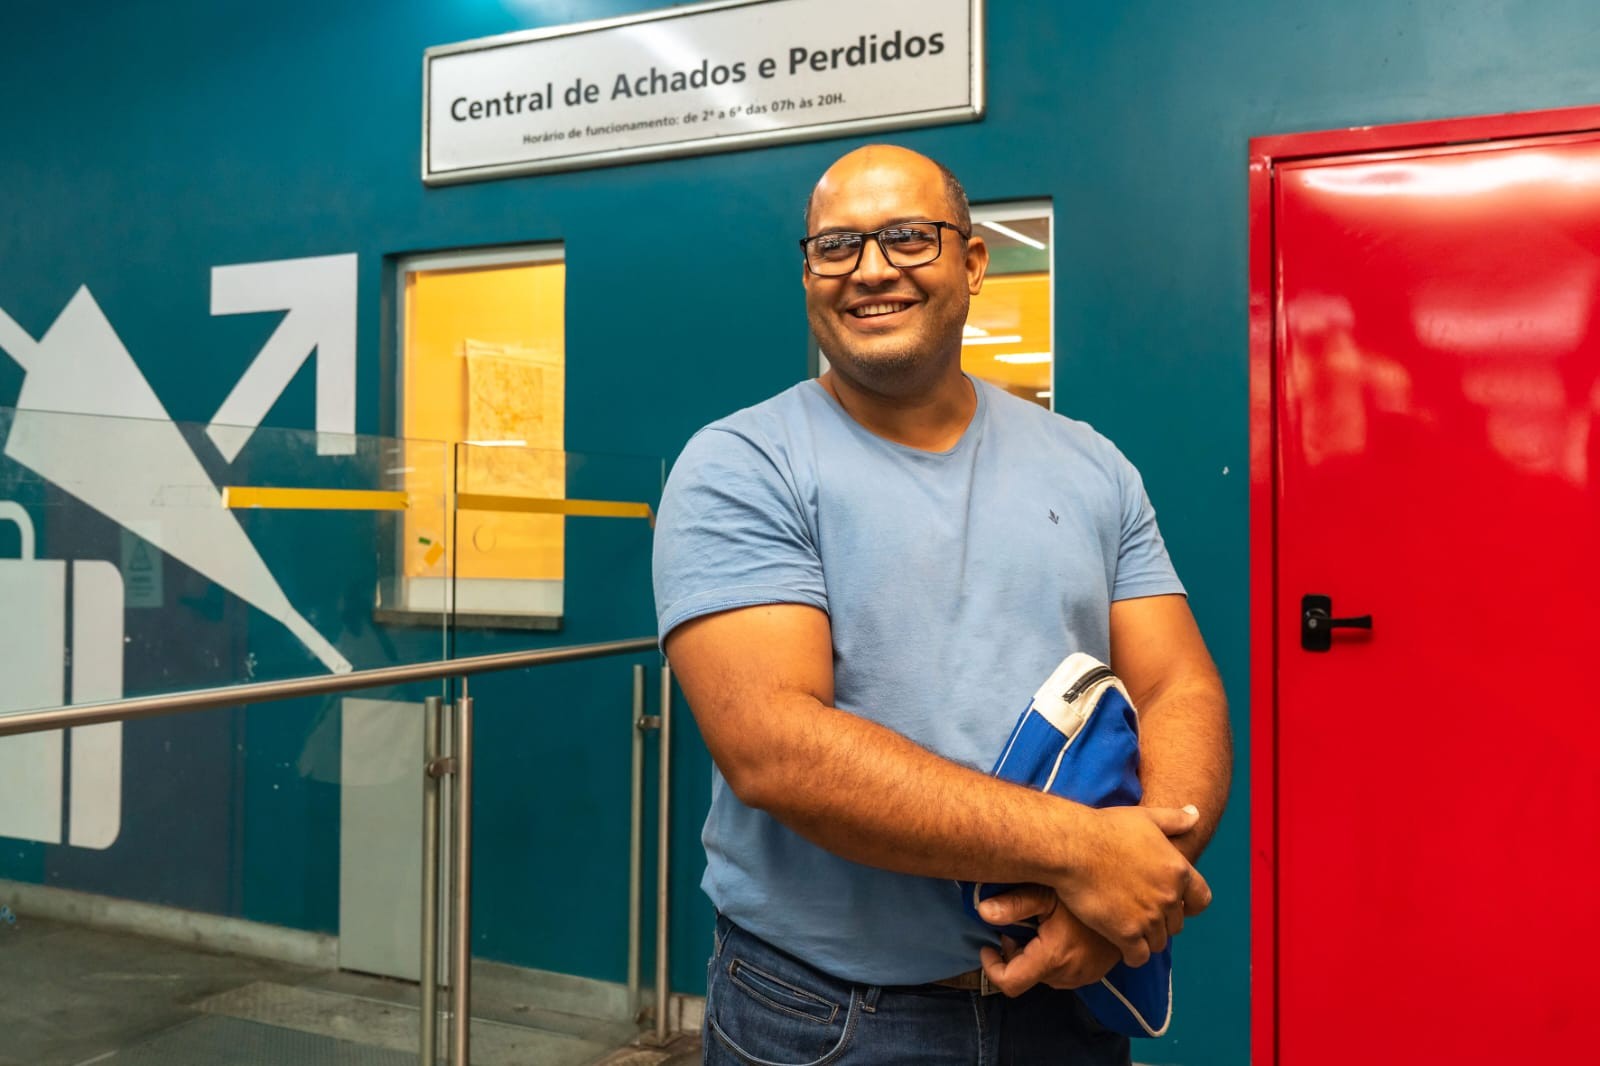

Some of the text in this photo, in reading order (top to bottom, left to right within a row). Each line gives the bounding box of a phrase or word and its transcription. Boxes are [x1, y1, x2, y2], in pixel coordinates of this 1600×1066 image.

[451, 30, 944, 122] Central de Achados e Perdidos
[521, 130, 566, 145] Horário
[567, 127, 583, 140] de
[585, 116, 679, 137] funcionamento:
[682, 112, 699, 124] de
[717, 110, 726, 120] a
[745, 103, 769, 116] das
[770, 98, 796, 113] 07h
[798, 98, 814, 109] às
[817, 92, 846, 107] 20H.
